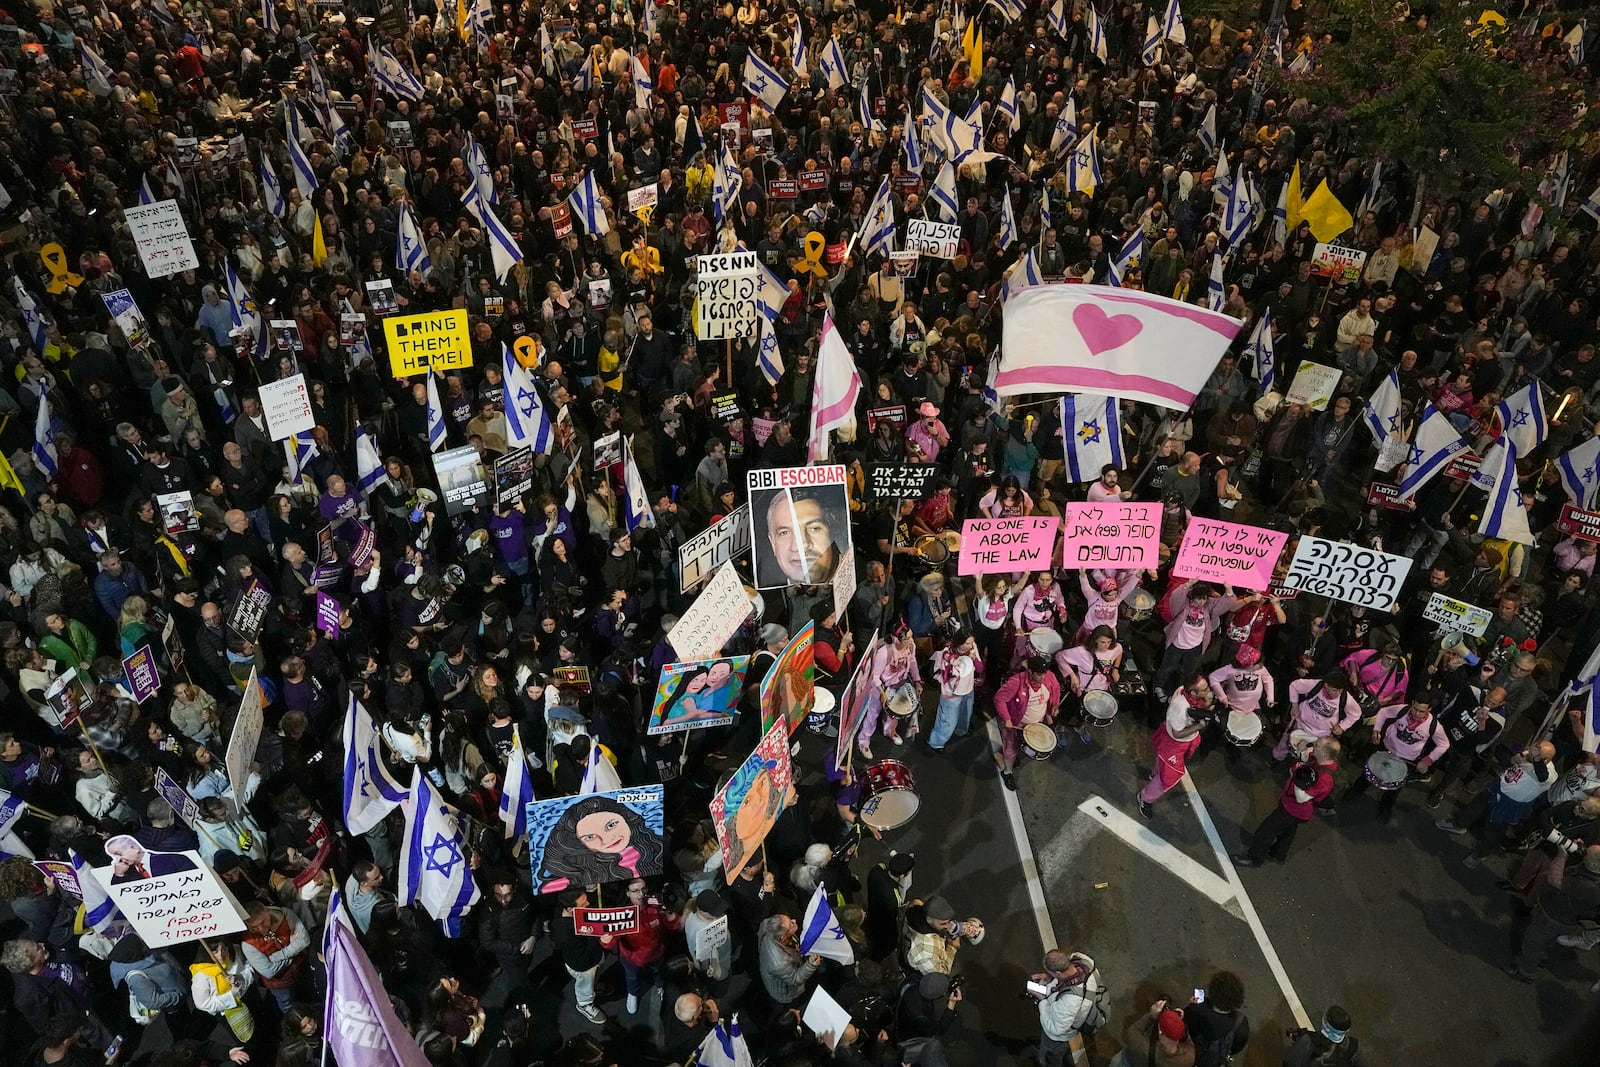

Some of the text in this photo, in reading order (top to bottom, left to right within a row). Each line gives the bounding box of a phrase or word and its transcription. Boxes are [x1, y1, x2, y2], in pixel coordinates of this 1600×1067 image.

[944, 242, 956, 257] תן
[396, 318, 456, 337] BRING
[708, 320, 756, 338] עלינו
[399, 337, 450, 352] THEM
[404, 350, 462, 369] HOME!
[750, 466, 845, 488] BIBI ESCOBAR
[872, 465, 935, 477] תציל את
[874, 478, 925, 486] המדינה
[873, 488, 922, 497] מעצמך
[1079, 506, 1149, 521] ביבי לא
[970, 520, 1048, 532] NO ONE IS
[1069, 525, 1092, 538] את
[1124, 525, 1155, 538] סופר
[1198, 524, 1229, 537] לדור
[980, 532, 1029, 546] ABOVE
[1235, 528, 1248, 541] לו
[1192, 538, 1269, 557] ששפטו את
[971, 548, 1040, 564] THE LAW
[1310, 541, 1396, 574] עסקה
[1348, 586, 1393, 608] רצח
[120, 874, 203, 896] מתי בפעם
[138, 889, 201, 908] האחרונה
[137, 898, 223, 920] עשית משהו
[588, 910, 634, 922] לחופש
[168, 913, 212, 928] בשביל
[608, 921, 634, 932] נולדו
